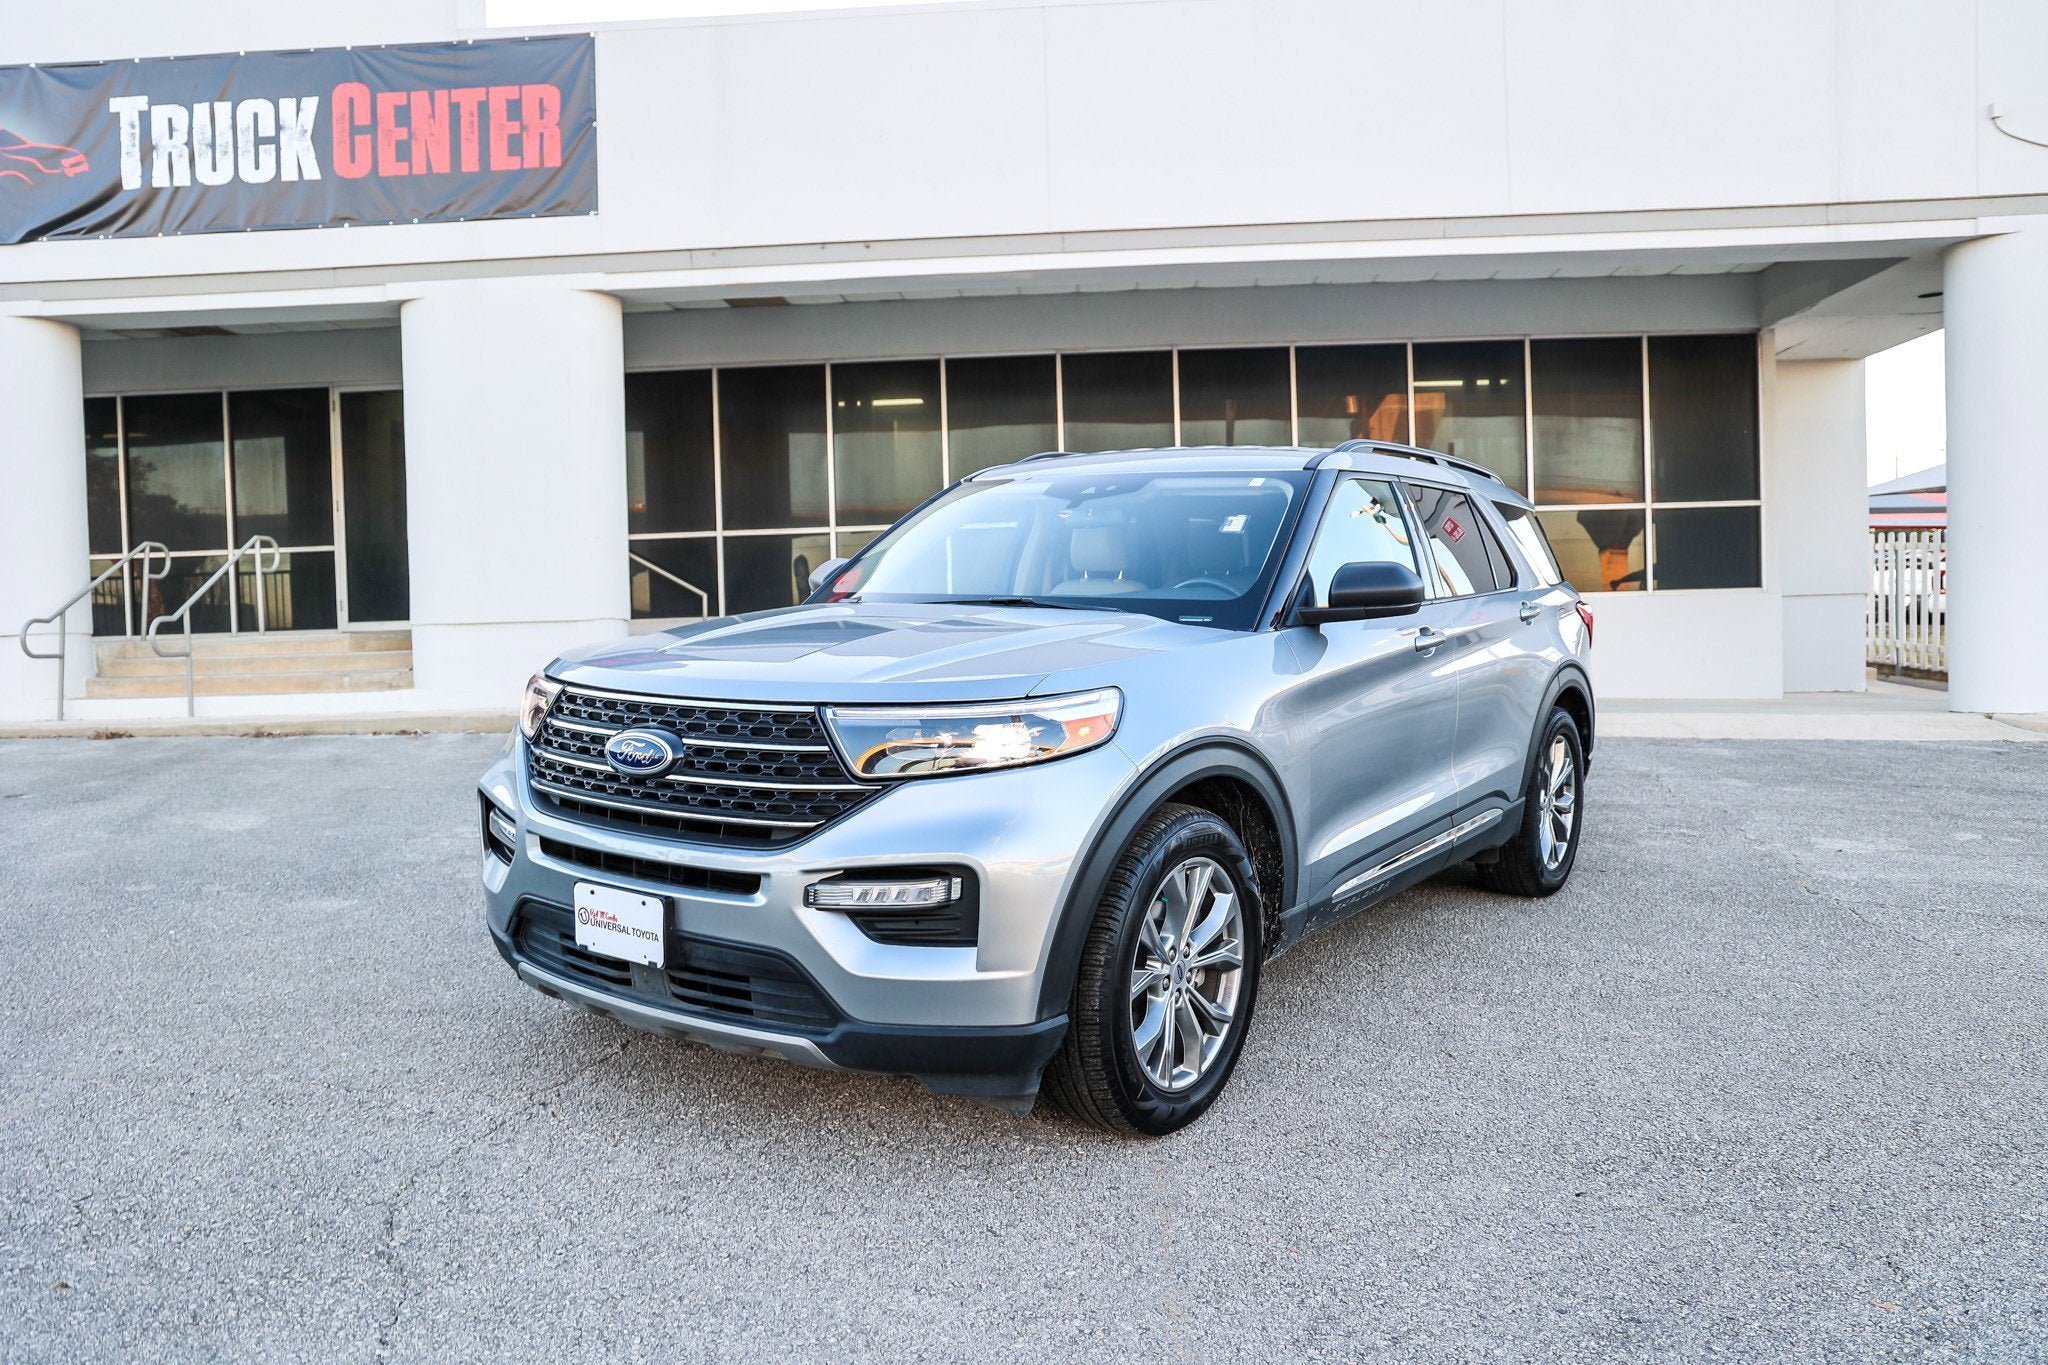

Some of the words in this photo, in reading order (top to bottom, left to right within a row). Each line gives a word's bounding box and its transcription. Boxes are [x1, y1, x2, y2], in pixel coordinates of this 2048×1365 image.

[109, 95, 321, 190] TRUCK
[332, 82, 562, 178] CENTER
[617, 740, 654, 764] Ford
[590, 917, 631, 936] UNIVERSAL
[631, 927, 660, 943] TOYOTA
